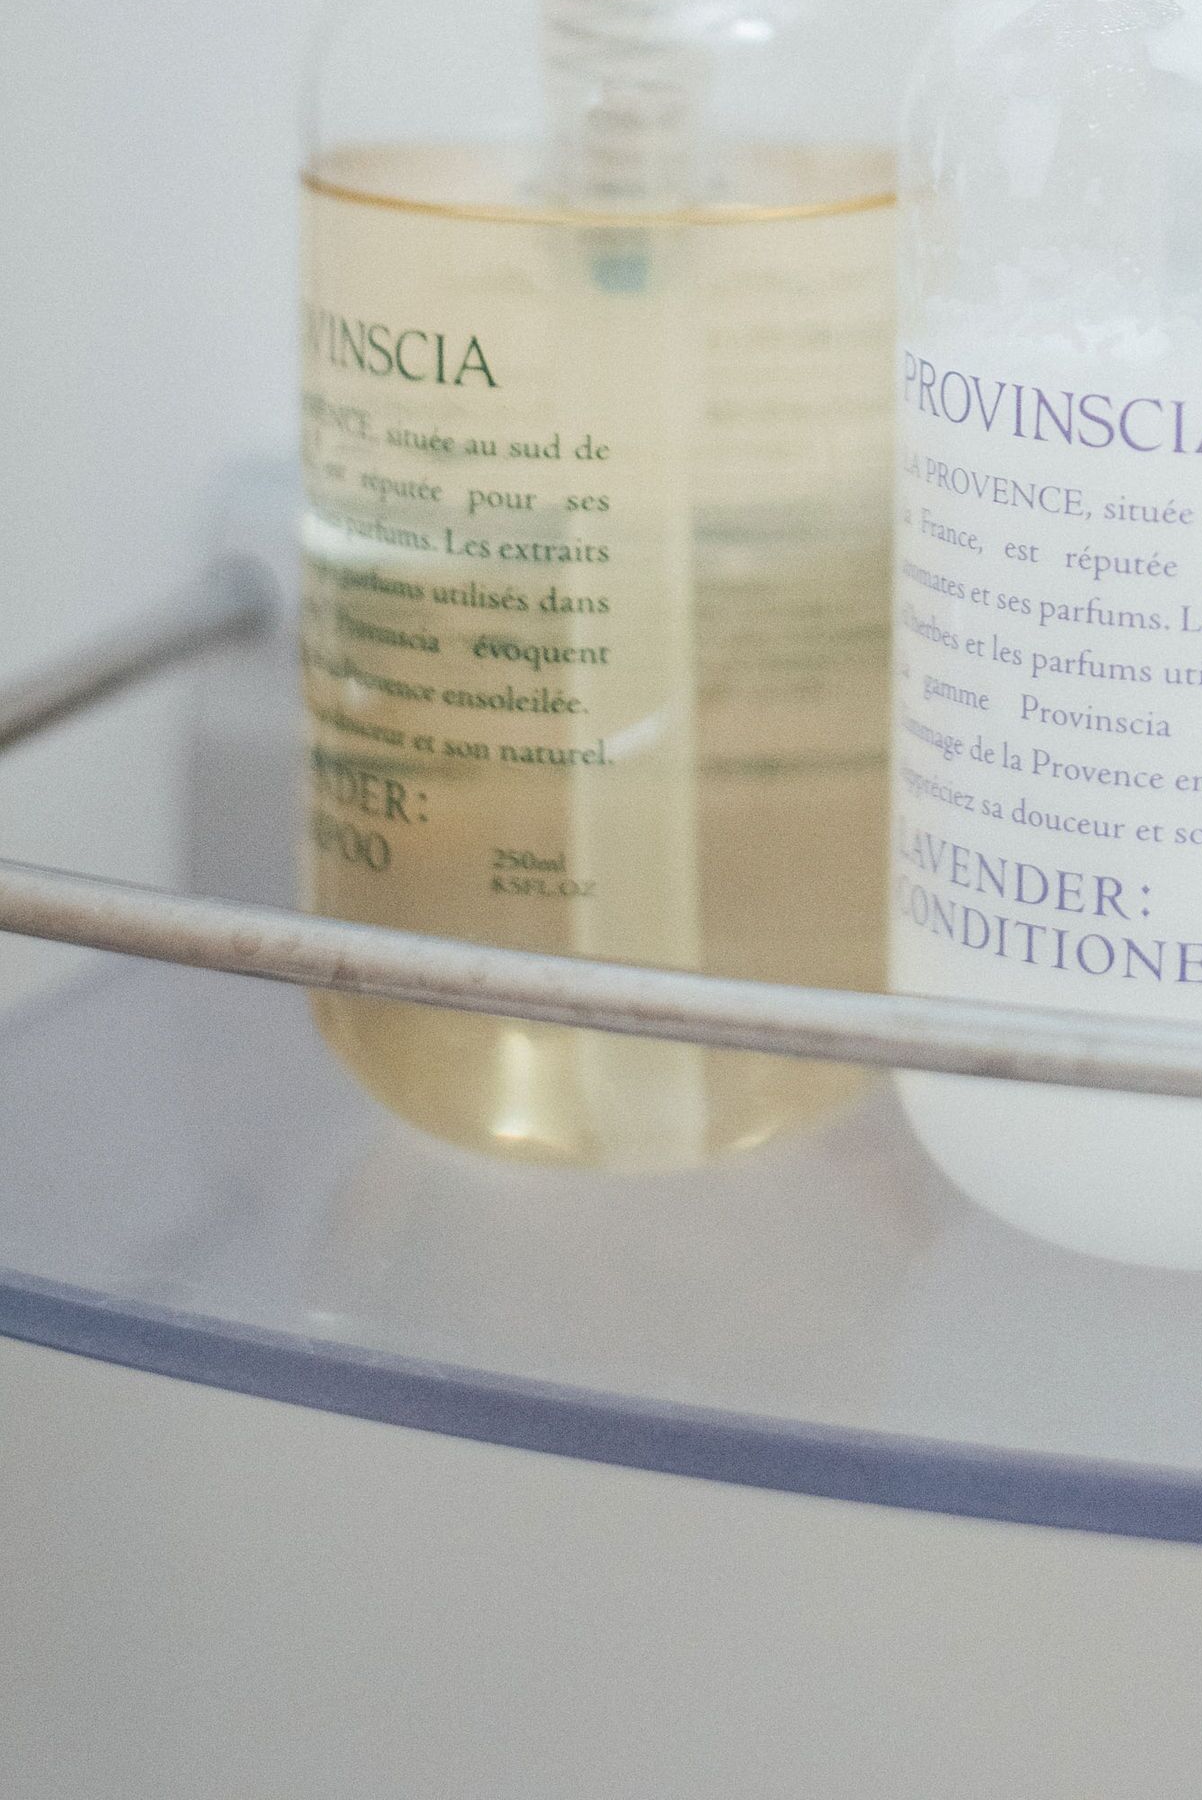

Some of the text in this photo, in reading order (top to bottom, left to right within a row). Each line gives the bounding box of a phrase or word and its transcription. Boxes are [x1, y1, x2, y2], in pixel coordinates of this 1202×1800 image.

[302, 304, 499, 388] INSCIA
[464, 440, 497, 456] au
[509, 433, 561, 460] sud
[574, 434, 610, 460] de
[468, 488, 536, 515] pour
[566, 494, 610, 512] ses
[925, 457, 1093, 520] PROVENCE,
[1103, 495, 1195, 525] située
[445, 527, 491, 558] Les
[498, 537, 610, 563] extraits
[920, 507, 984, 556] France,
[1004, 539, 1039, 564] est
[1065, 545, 1180, 586] réputée
[433, 580, 529, 613] utilisés
[540, 586, 610, 614] dans
[970, 583, 991, 607] et
[996, 590, 1032, 616] ses
[1039, 596, 1170, 631] parfums.
[472, 633, 610, 673] évoquent
[966, 636, 985, 657] et
[992, 636, 1023, 667] les
[1031, 649, 1153, 684] parfums
[442, 685, 589, 715] ensoleilée.
[922, 674, 991, 712] gamme
[1020, 693, 1172, 739] Provinscia
[444, 740, 491, 760] son
[500, 738, 616, 766] naturel.
[969, 737, 996, 764] de
[1002, 741, 1022, 771] la
[1031, 748, 1165, 790] Provence
[318, 762, 428, 824] DER:
[981, 796, 1003, 820] sa
[1011, 798, 1125, 839] douceur
[1136, 823, 1163, 842] et
